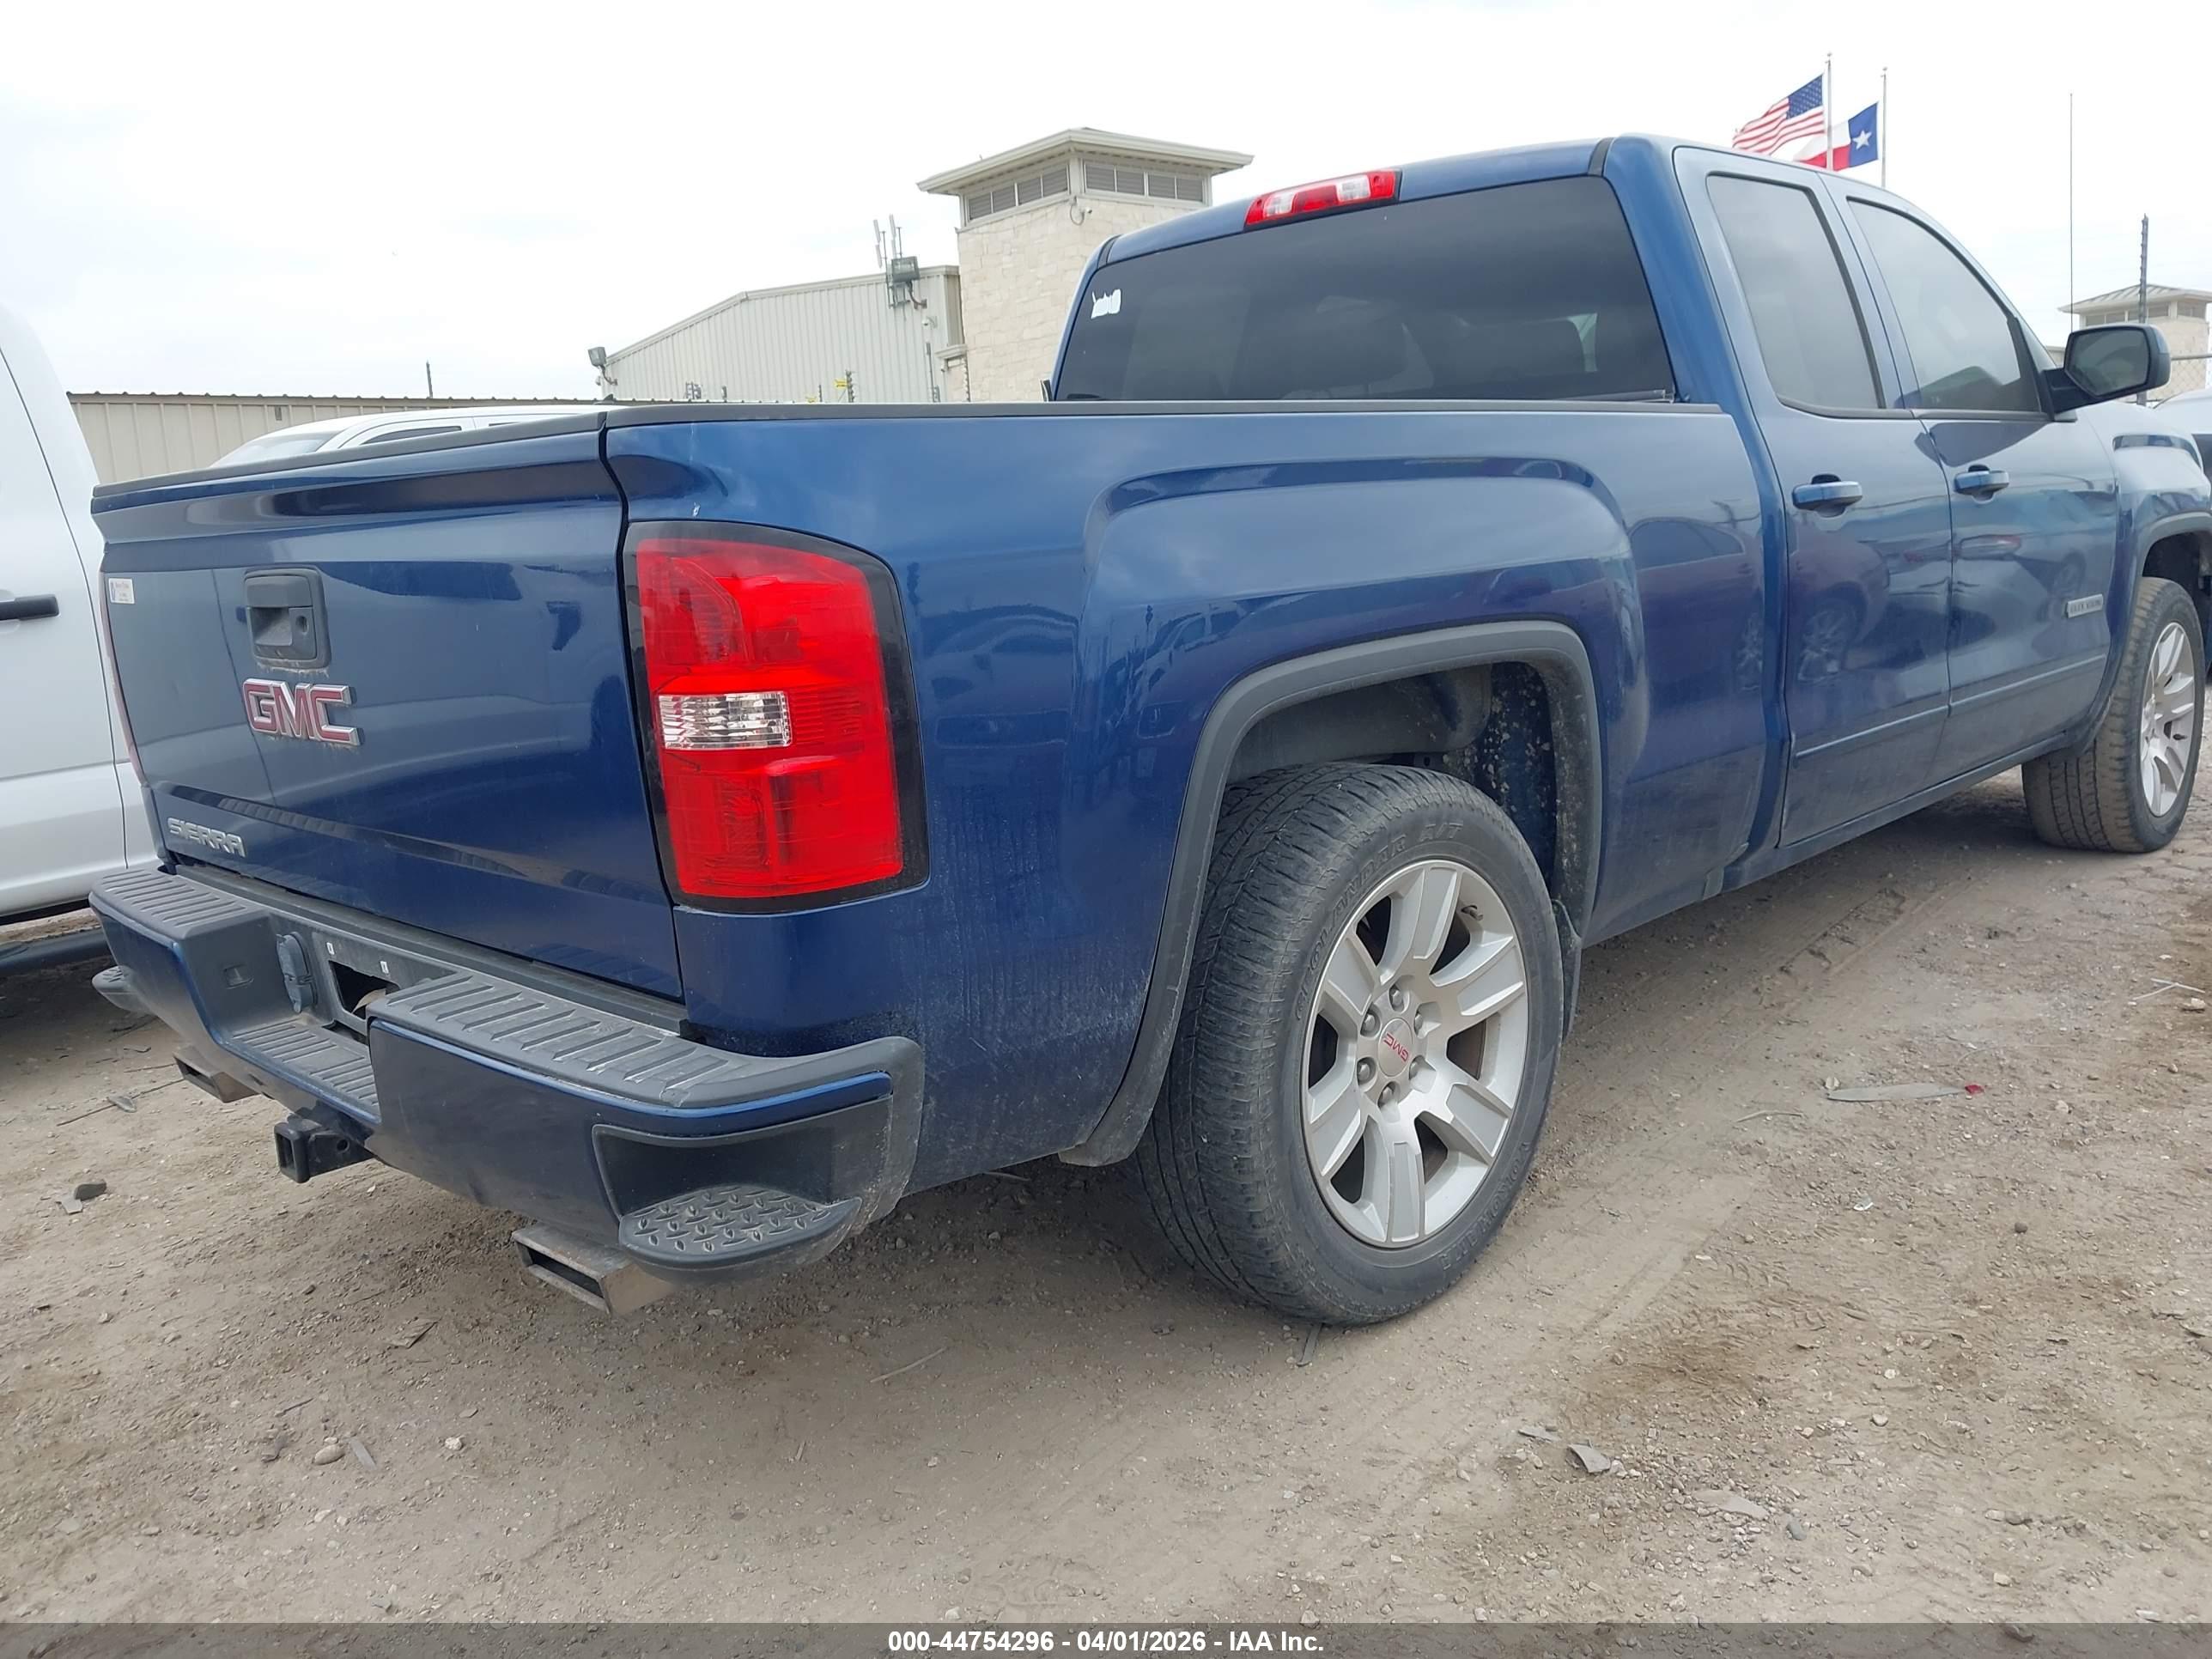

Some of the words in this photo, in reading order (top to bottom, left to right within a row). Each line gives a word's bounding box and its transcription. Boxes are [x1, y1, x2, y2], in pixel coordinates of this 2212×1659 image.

[243, 678, 360, 745] GMC
[167, 817, 246, 857] SIERRA
[1382, 1031, 1410, 1063] GMC
